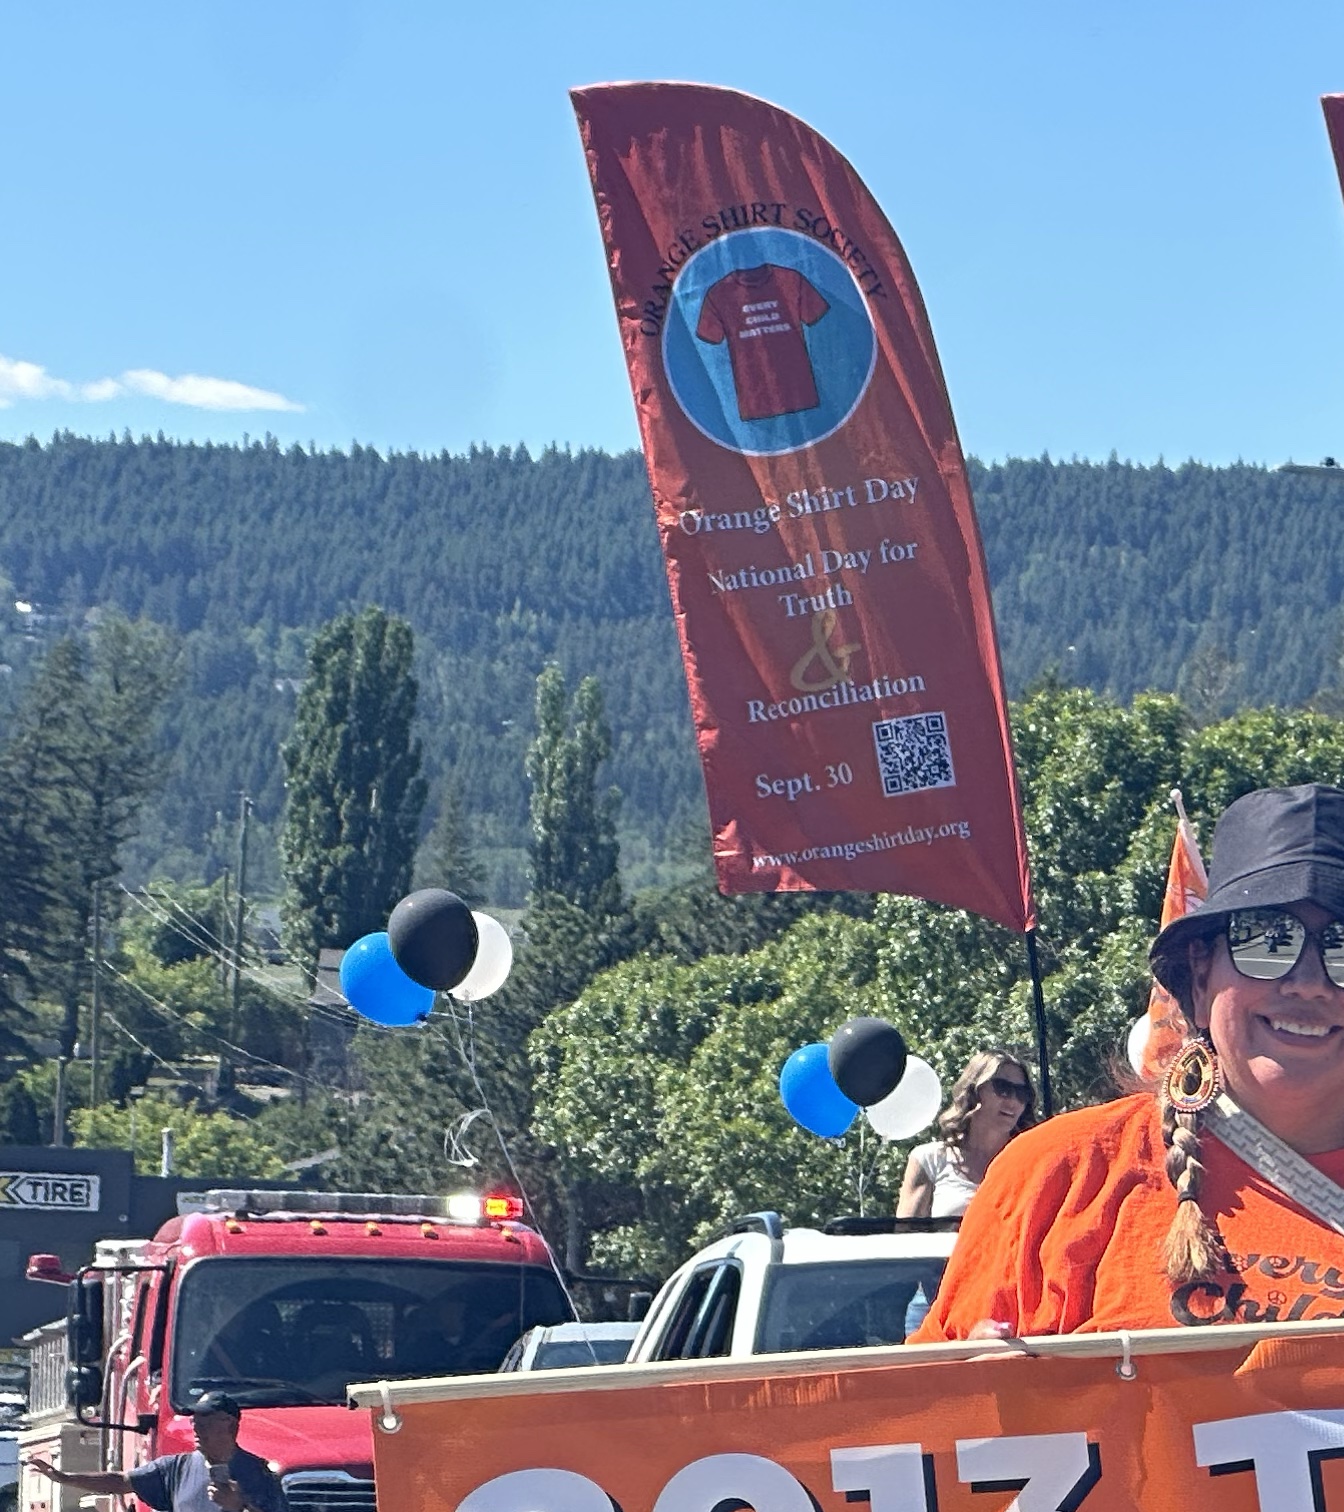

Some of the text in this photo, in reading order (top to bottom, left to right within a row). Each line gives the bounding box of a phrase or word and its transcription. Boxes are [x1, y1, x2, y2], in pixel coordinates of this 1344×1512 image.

[641, 203, 887, 337] ORANGE SHIRT SOCIETY
[678, 476, 920, 536] Orange Shirt Day
[707, 539, 919, 595] National Day for
[778, 584, 854, 619] Truth
[790, 609, 861, 692] &
[746, 674, 926, 724] Reconciliation
[755, 762, 854, 801] Sept. 30
[752, 818, 971, 869] www.orangeshirtday.org
[26, 1181, 85, 1202] TIRE
